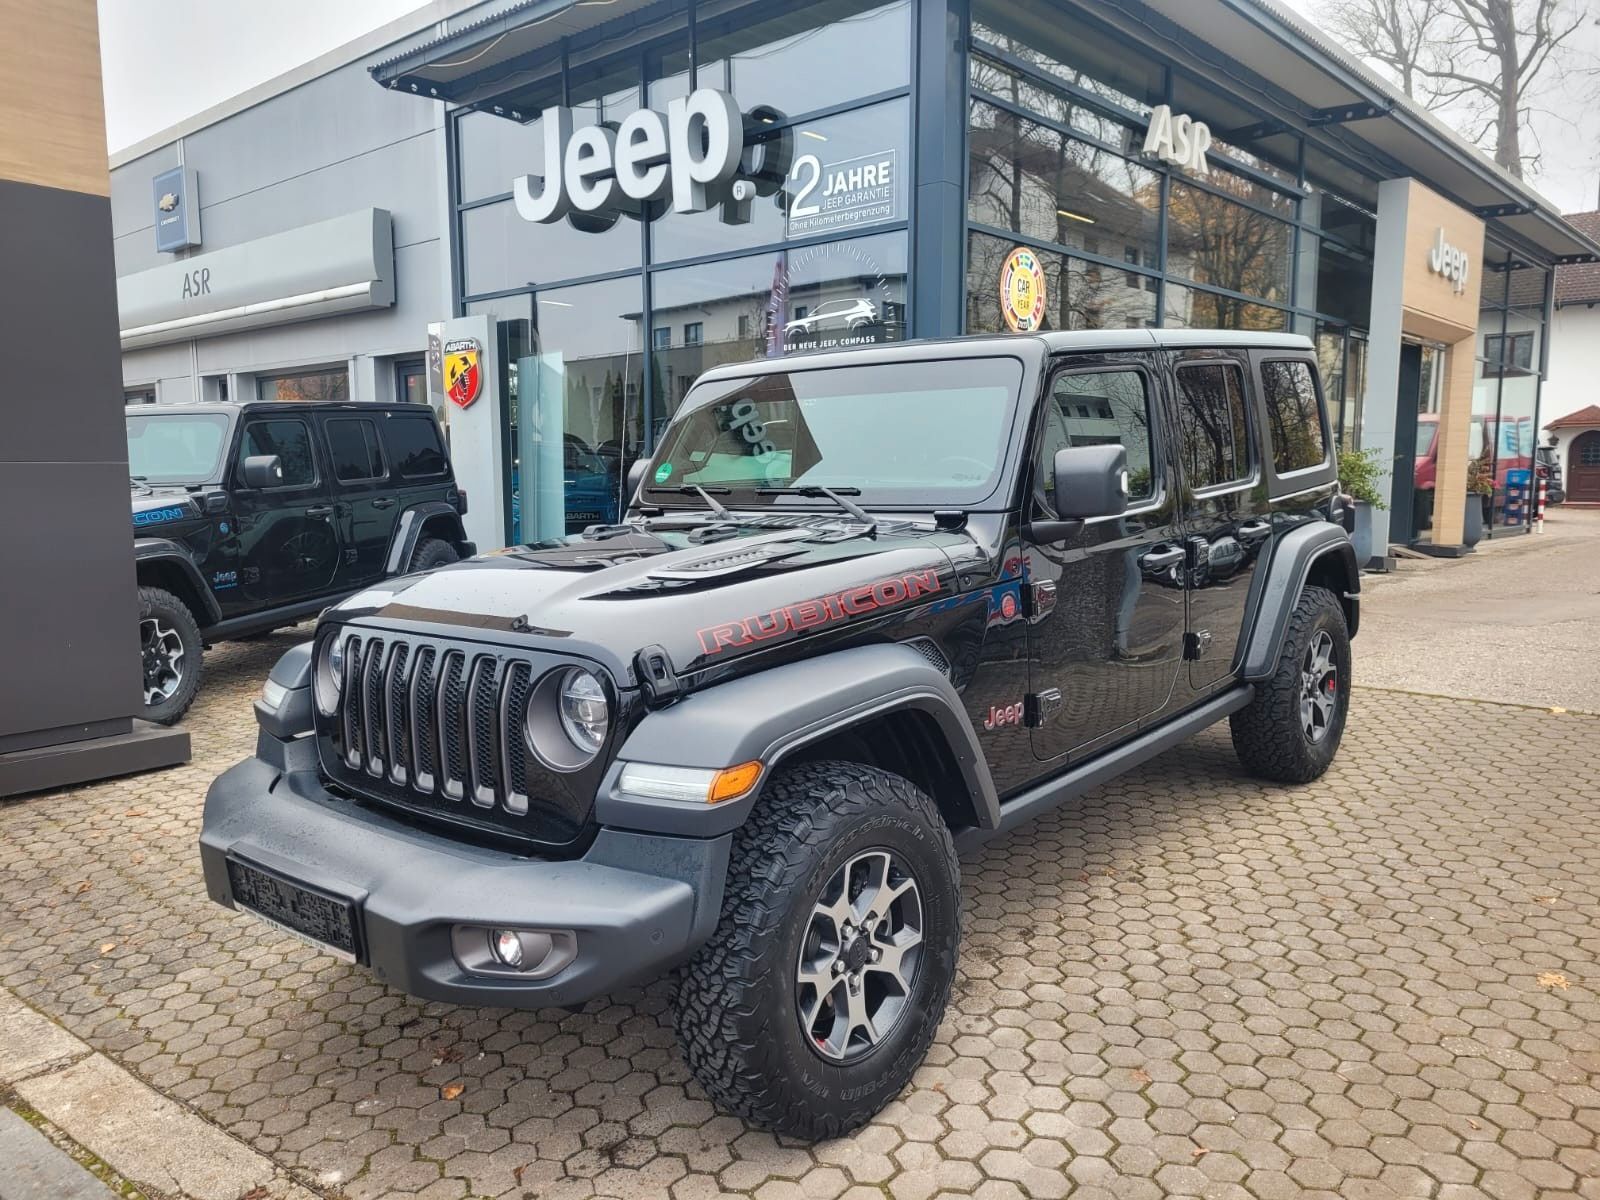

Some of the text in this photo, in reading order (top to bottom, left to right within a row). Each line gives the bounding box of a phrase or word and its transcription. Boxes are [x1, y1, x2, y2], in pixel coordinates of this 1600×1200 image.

[1143, 105, 1212, 174] ASR
[514, 88, 738, 222] Jeep
[789, 154, 890, 218] 2 JAHRE
[822, 186, 890, 210] JEEP GARANTIE
[790, 205, 890, 231] Ohne Kilometerbegrenzung
[1428, 226, 1468, 292] Jeep
[182, 267, 211, 299] ASR
[1018, 278, 1030, 295] CAR
[1018, 299, 1030, 309] YEAR
[445, 341, 477, 353] ABARTH
[783, 343, 797, 351] DER
[799, 341, 817, 349] NEUE
[840, 335, 875, 346] COMPASS
[566, 512, 599, 520] BARTH
[213, 571, 237, 583] Jeep
[697, 569, 941, 656] RUBICON
[984, 702, 1025, 731] Jeep
